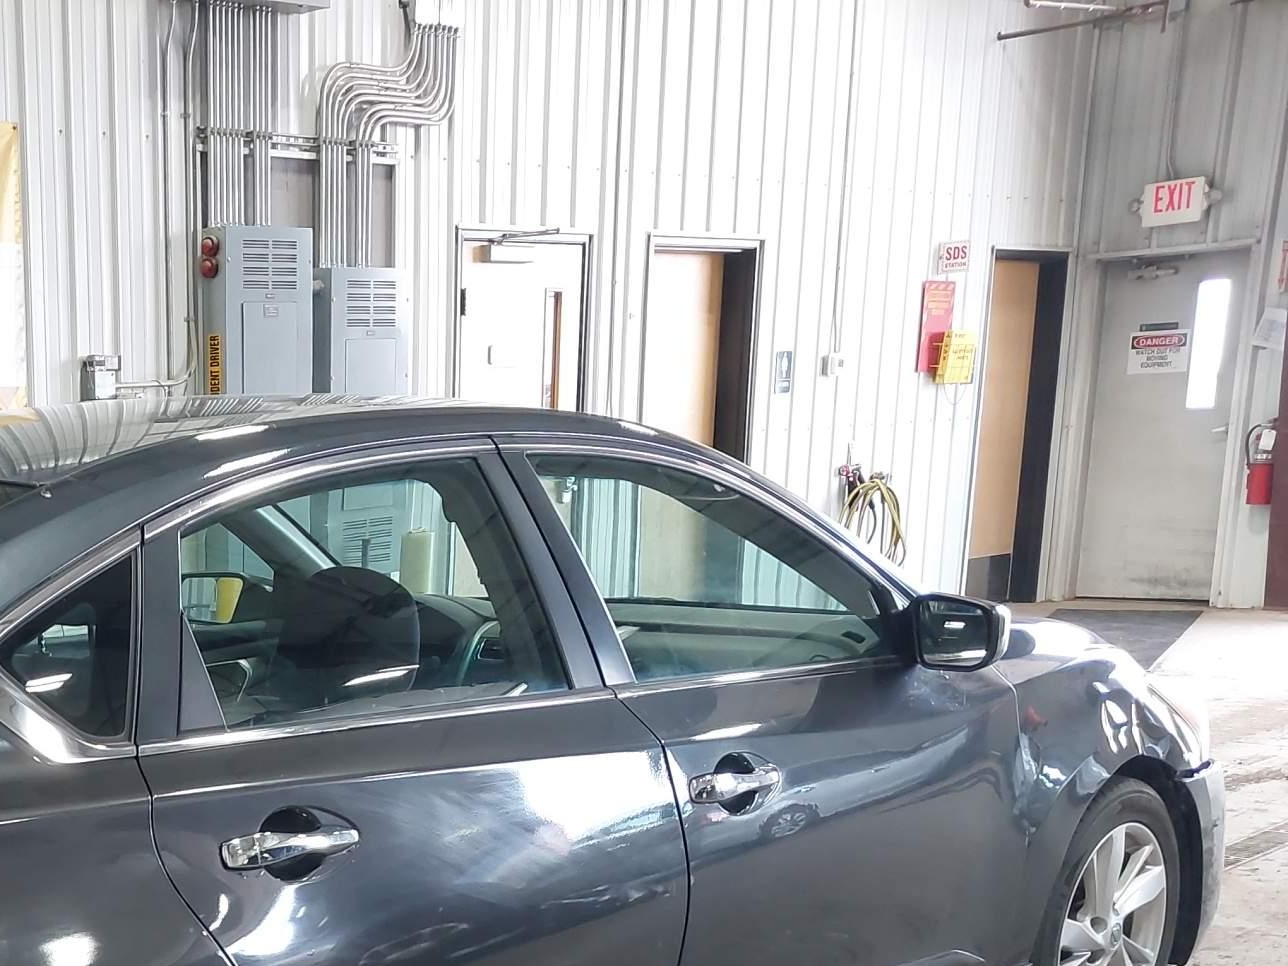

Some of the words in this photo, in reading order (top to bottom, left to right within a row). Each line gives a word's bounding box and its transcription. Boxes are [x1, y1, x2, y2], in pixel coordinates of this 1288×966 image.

[1153, 181, 1196, 213] EXIT
[946, 246, 967, 260] SDS
[210, 335, 220, 367] DRIVER
[1139, 336, 1179, 346] DANGER
